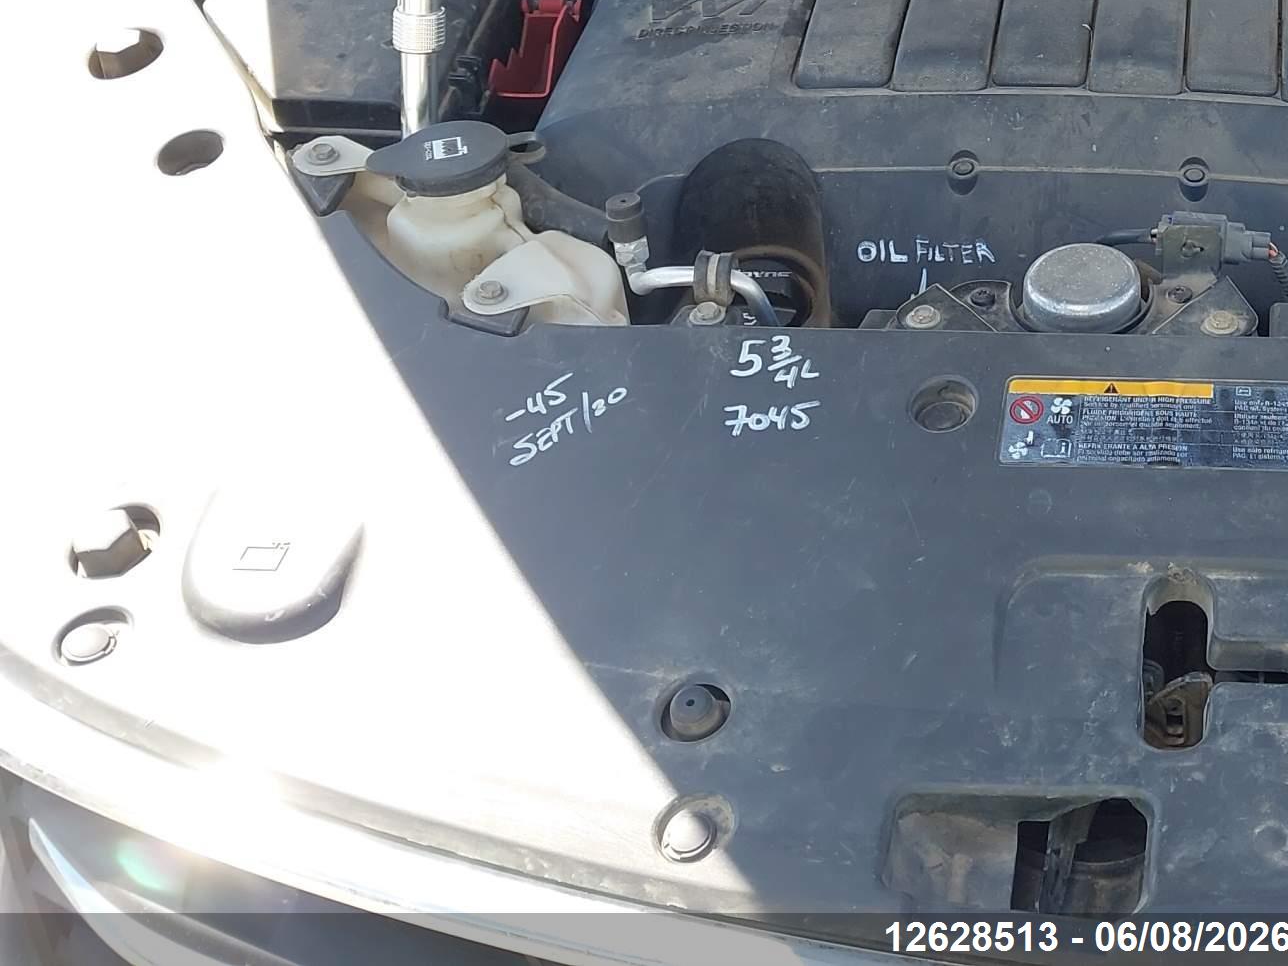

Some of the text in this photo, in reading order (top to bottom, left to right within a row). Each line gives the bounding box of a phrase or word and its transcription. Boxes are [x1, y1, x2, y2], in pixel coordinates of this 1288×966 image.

[857, 237, 996, 265] OIL FILTER
[724, 400, 821, 436] 7045
[1046, 415, 1074, 425] AUTO
